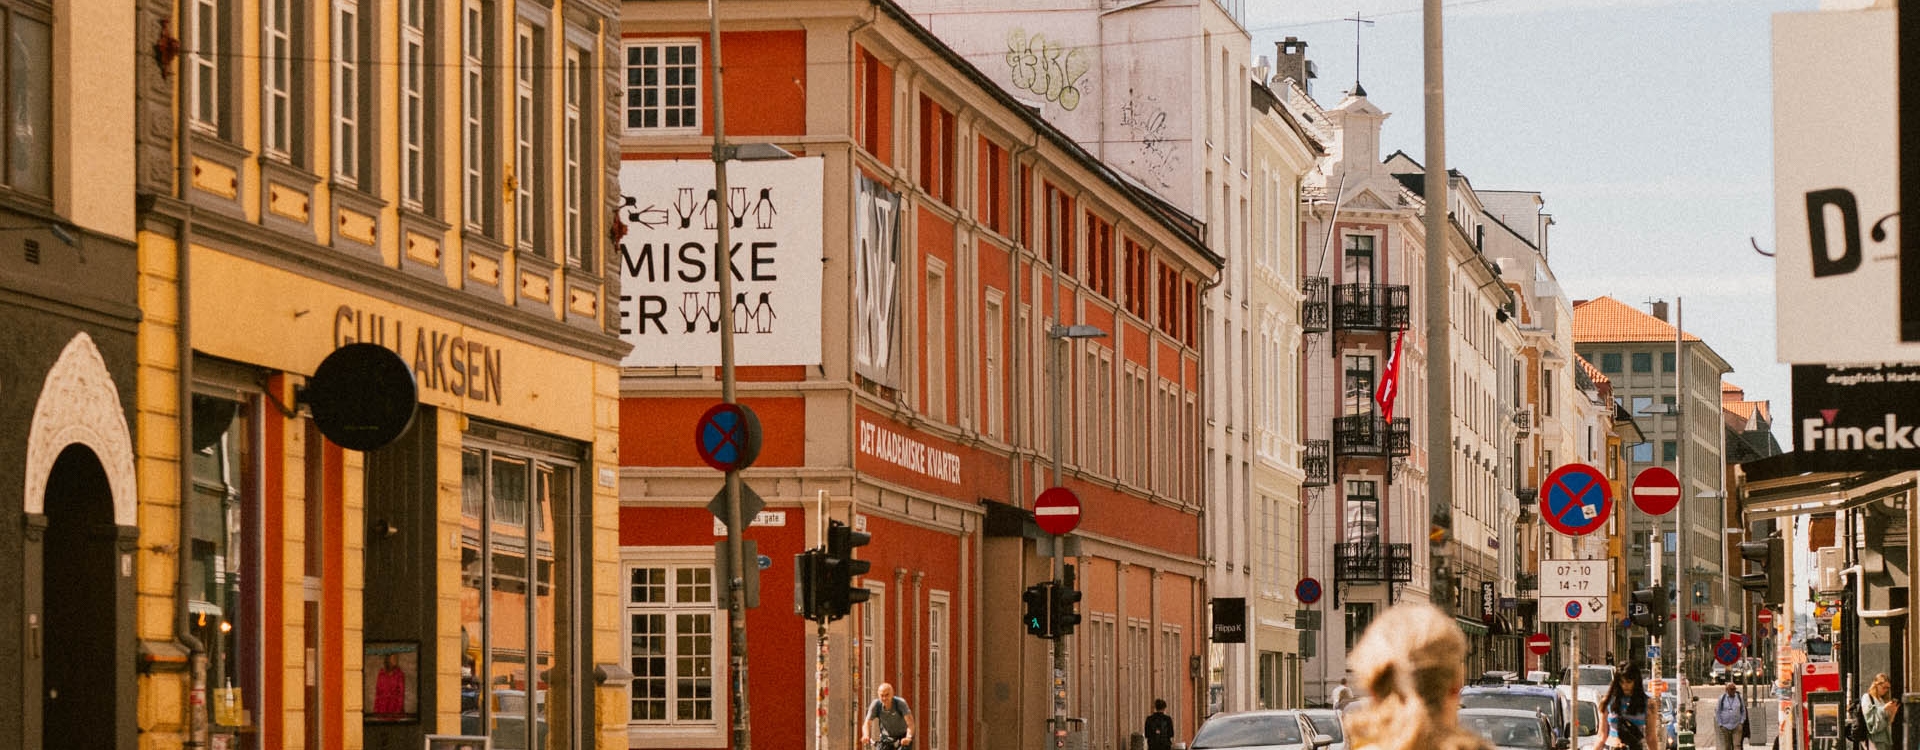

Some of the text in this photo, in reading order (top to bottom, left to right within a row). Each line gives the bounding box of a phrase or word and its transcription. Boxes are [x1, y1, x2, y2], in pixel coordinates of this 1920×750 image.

[861, 420, 960, 485] DET AKADEMISKE KVARTER
[765, 514, 779, 525] gate
[1557, 566, 1571, 576] 07
[1580, 566, 1591, 576] 10
[1559, 581, 1569, 590] 14
[1578, 581, 1589, 590] 17
[1215, 624, 1242, 633] Filippa K
